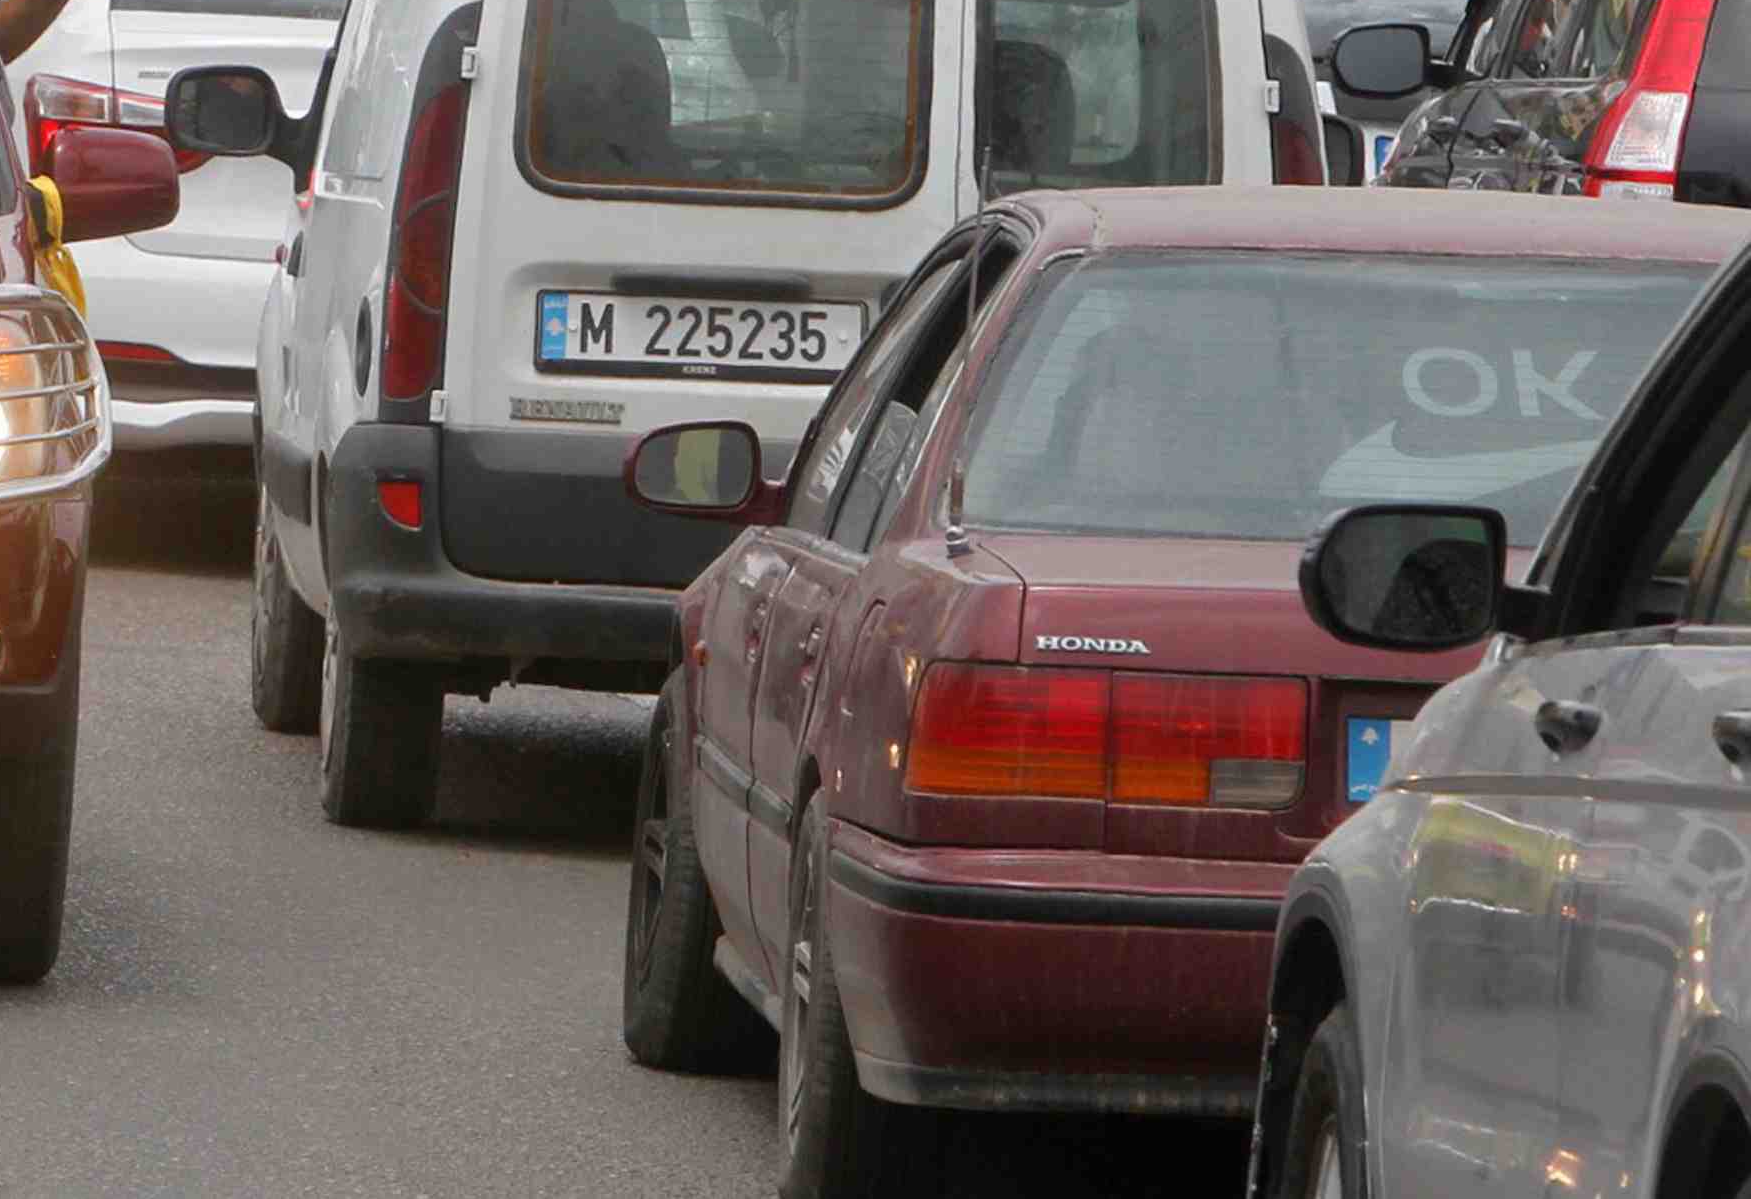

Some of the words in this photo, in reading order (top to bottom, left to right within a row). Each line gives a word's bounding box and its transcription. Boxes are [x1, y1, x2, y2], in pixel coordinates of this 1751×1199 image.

[579, 302, 615, 354] M
[645, 304, 828, 362] 225235
[1402, 347, 1610, 421] OK
[509, 397, 625, 423] RENAULT
[1036, 635, 1151, 654] HONDA
